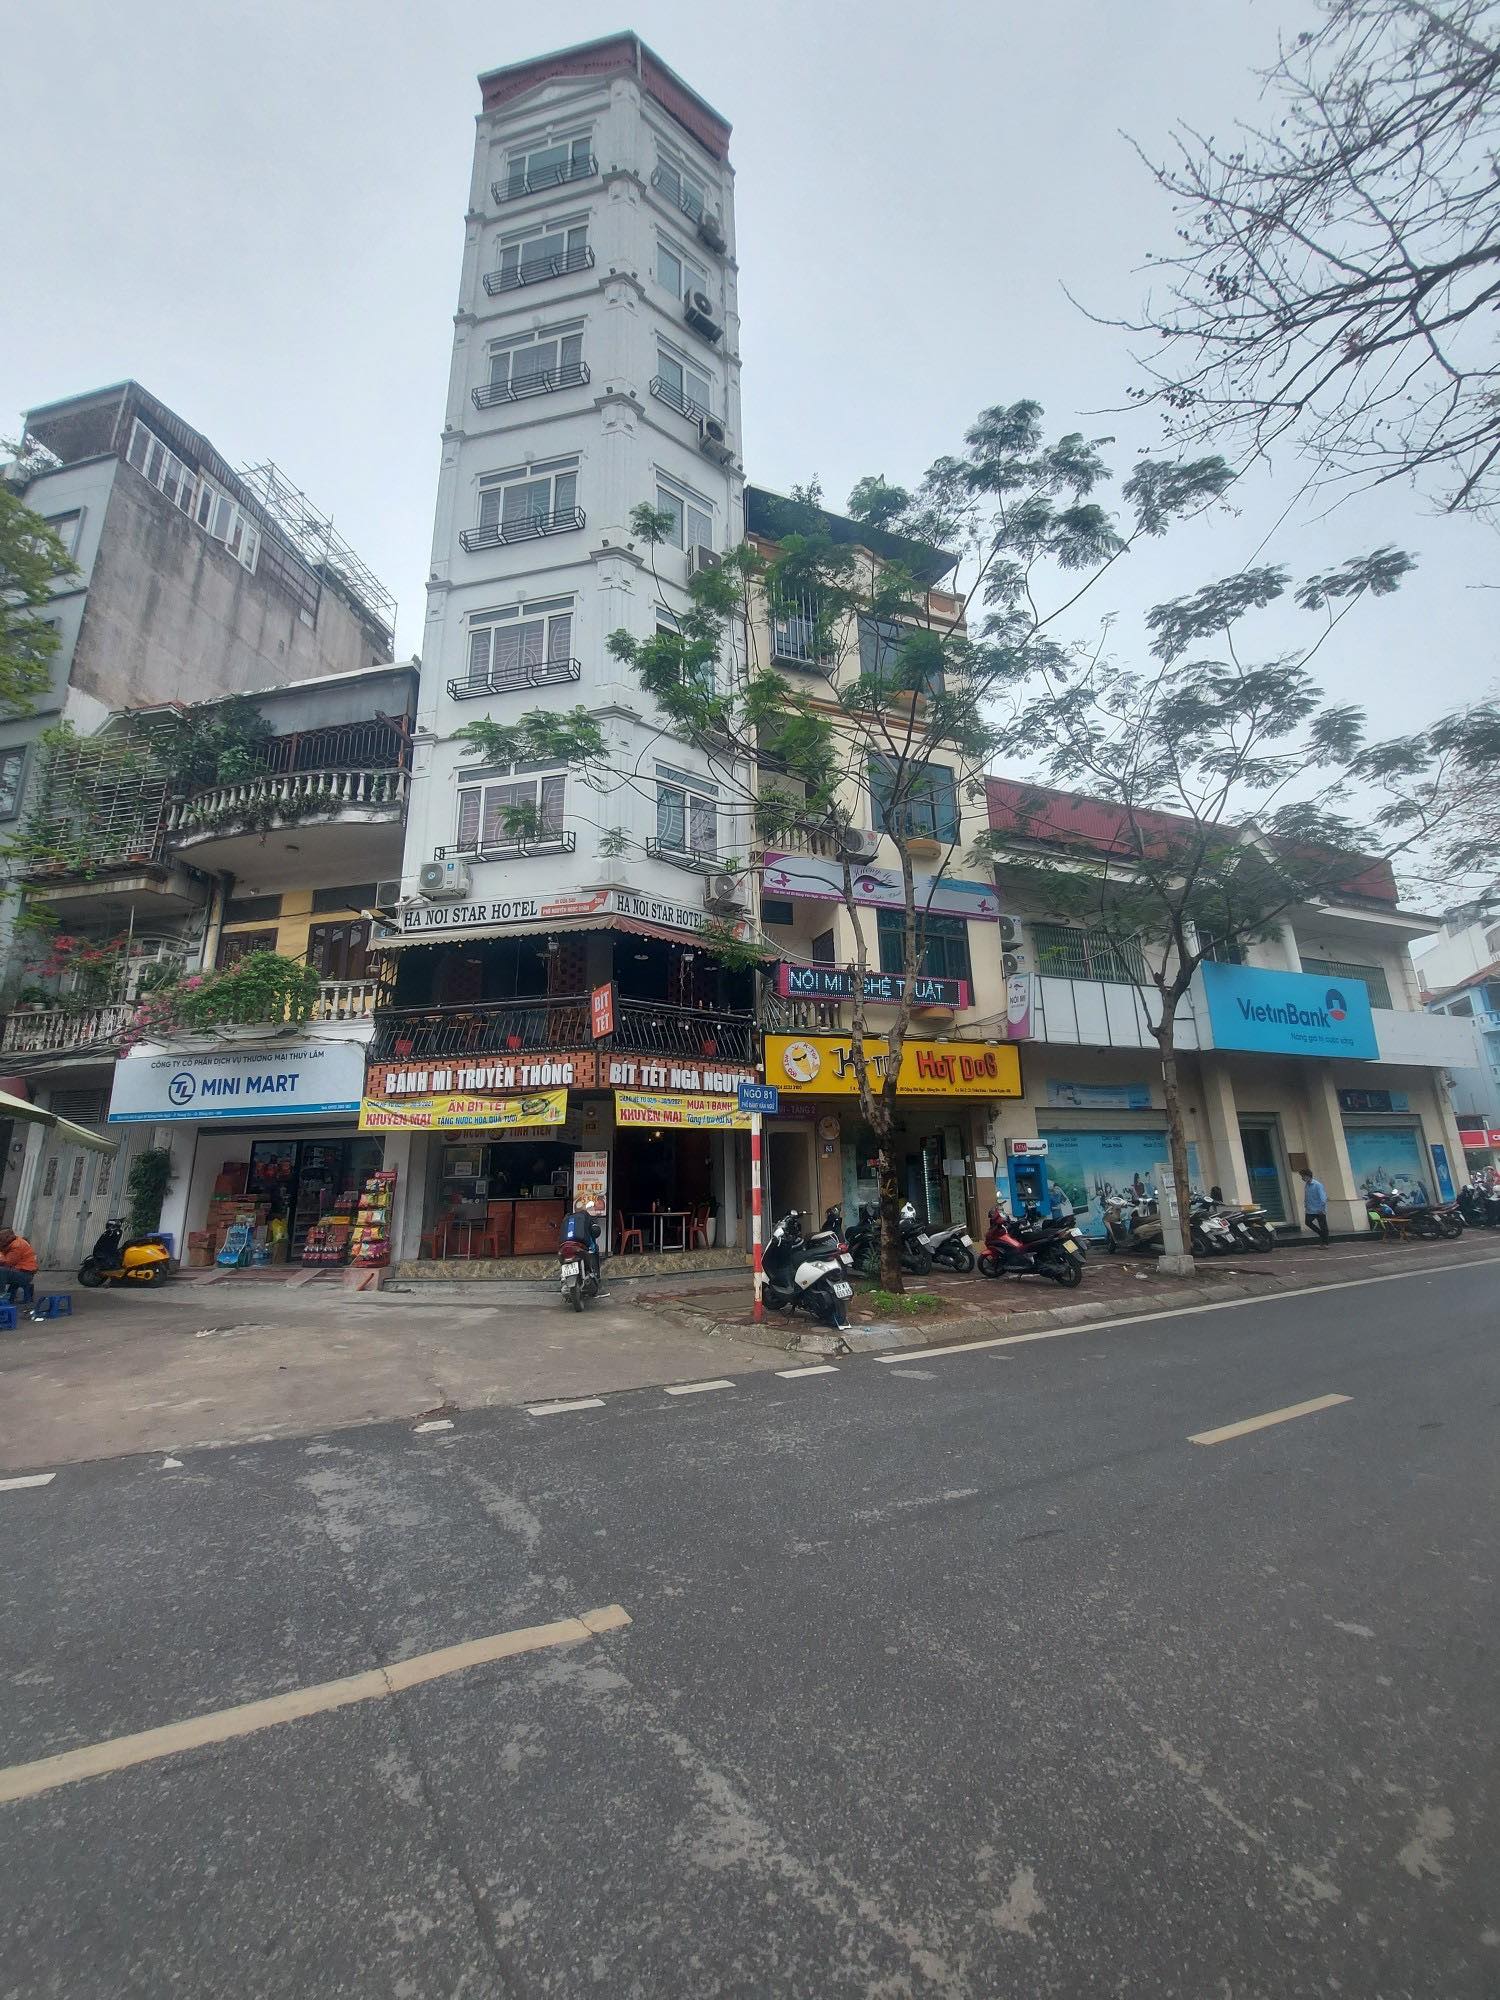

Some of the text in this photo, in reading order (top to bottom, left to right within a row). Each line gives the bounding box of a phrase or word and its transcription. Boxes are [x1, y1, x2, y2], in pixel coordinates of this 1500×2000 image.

[404, 900, 538, 927] HA NOI STAR HOTEL
[617, 894, 702, 926] HA NOI STAR HOTEL
[825, 974, 842, 991] MI
[896, 980, 944, 1000] TUẬT
[1236, 997, 1331, 1029] VietinBank
[151, 1060, 171, 1069] CÔNG
[386, 1068, 428, 1094] BÁNH
[432, 1066, 453, 1091] MÌ
[520, 1057, 574, 1087] THỐNG
[609, 1060, 637, 1085] BÍT
[641, 1060, 668, 1088] TẾT
[671, 1067, 700, 1090] NGÀ
[201, 1077, 241, 1097] MINI
[246, 1073, 300, 1094] MART
[743, 1087, 761, 1099] NGÕ
[763, 1090, 773, 1100] 81
[687, 1100, 704, 1110] MUA
[707, 1101, 710, 1110] 1
